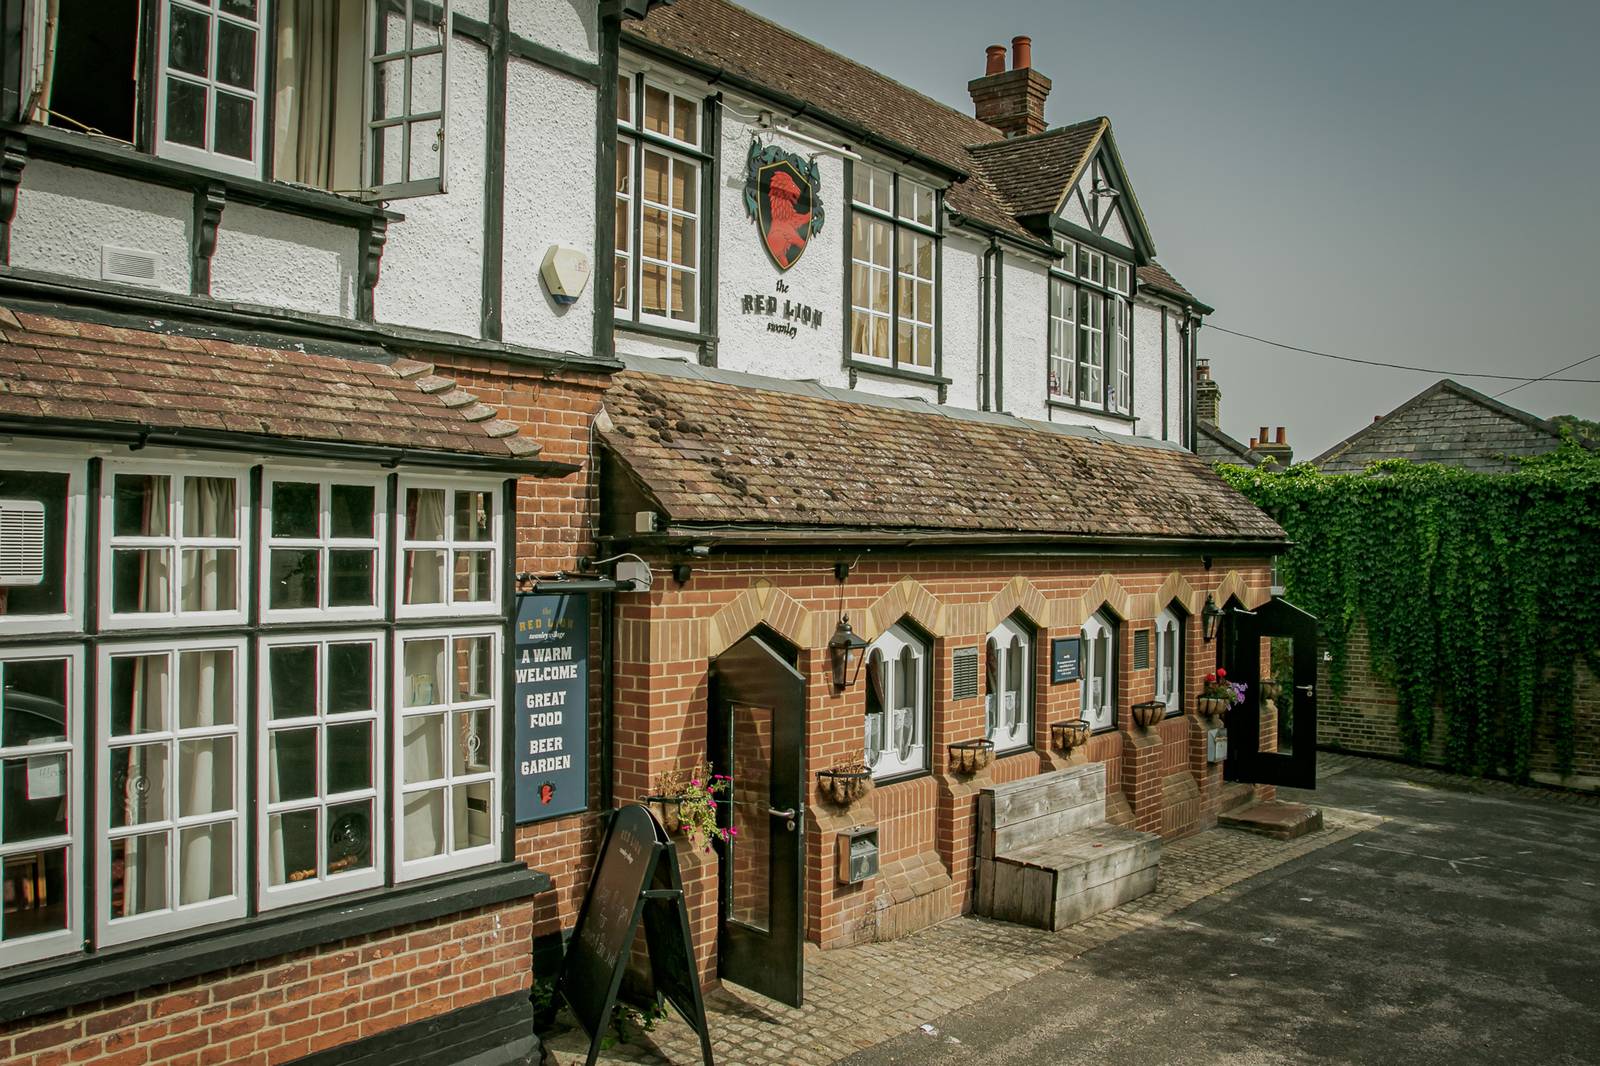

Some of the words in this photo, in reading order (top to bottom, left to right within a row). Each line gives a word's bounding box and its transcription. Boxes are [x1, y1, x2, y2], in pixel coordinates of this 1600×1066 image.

[776, 279, 789, 293] the
[742, 294, 777, 315] RED
[784, 299, 822, 329] LION
[519, 618, 542, 632] RED
[521, 649, 531, 664] A
[533, 646, 572, 662] WARM
[515, 664, 578, 684] WELCOME
[526, 690, 567, 709] GREAT
[530, 711, 563, 729] FOOD
[529, 736, 563, 754] BEER
[521, 754, 571, 776] GARDEN
